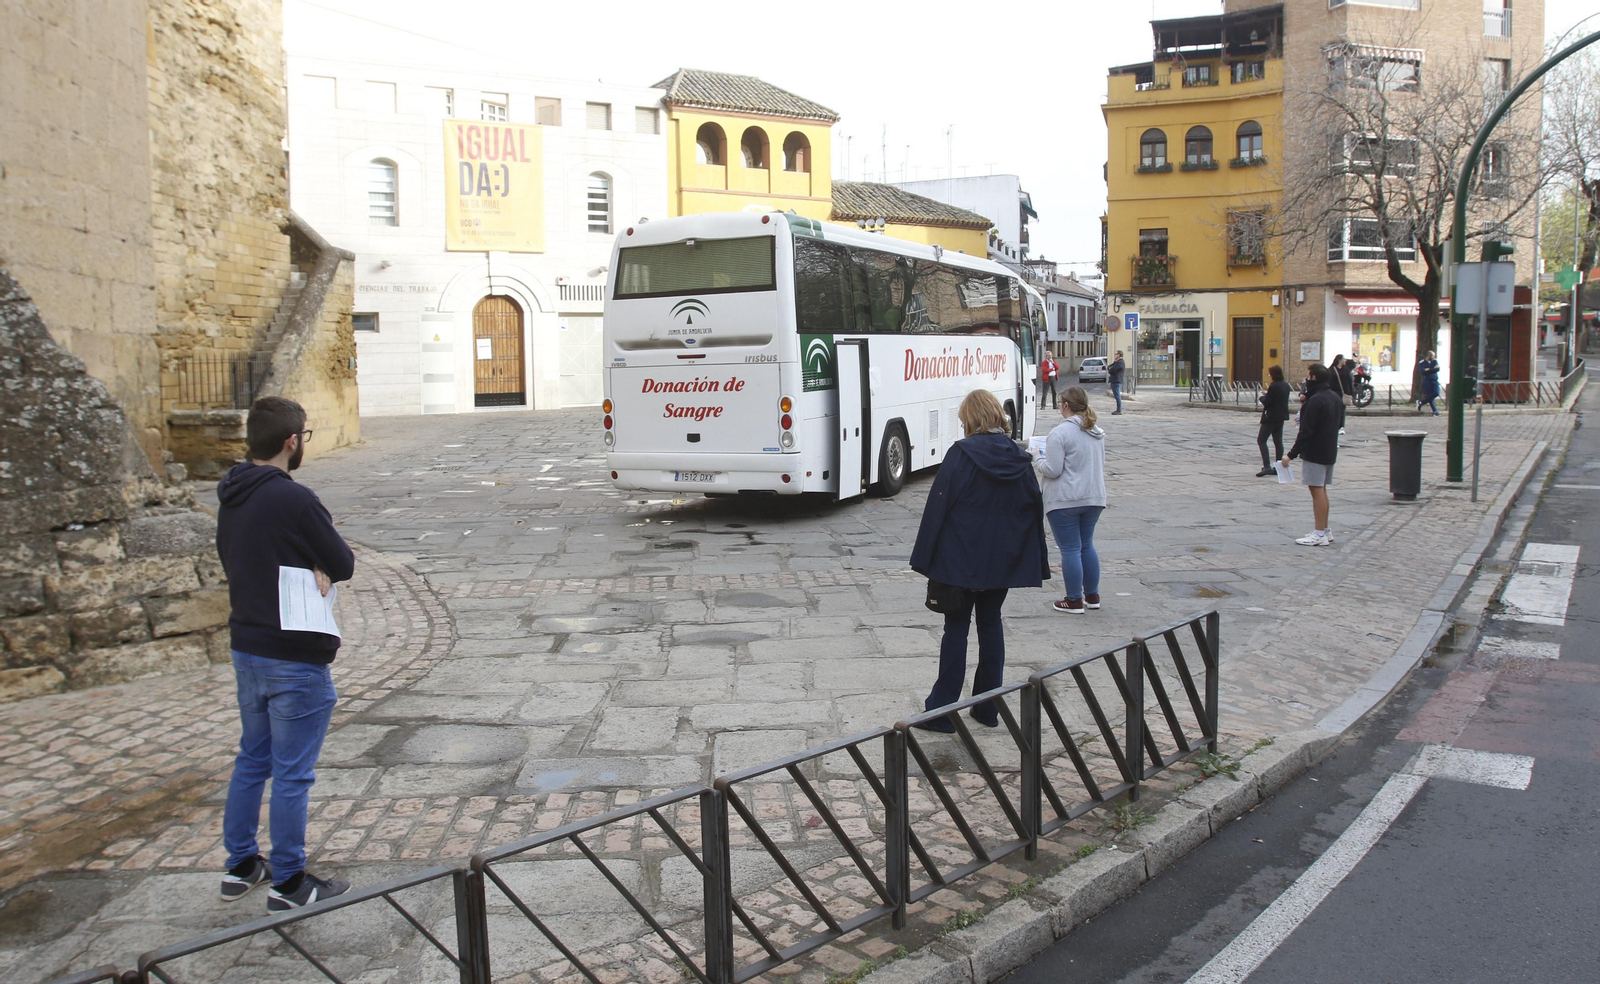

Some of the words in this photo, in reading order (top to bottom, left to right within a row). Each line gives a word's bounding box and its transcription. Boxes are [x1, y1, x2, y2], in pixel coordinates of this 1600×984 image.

[457, 124, 531, 163] IGUAL
[459, 199, 469, 208] NO
[471, 199, 479, 208] DA
[482, 199, 500, 210] IGUAL
[409, 285, 438, 293] TRABAJO
[1138, 303, 1199, 314] FARMACIA
[744, 353, 778, 363] irisbus
[904, 346, 959, 382] Donación
[961, 348, 974, 377] de
[975, 347, 1007, 381] Sangre
[641, 376, 720, 393] Donación
[723, 376, 745, 392] de
[663, 403, 724, 422] Sangre
[681, 472, 698, 481] 1512
[699, 473, 714, 482] DXX
